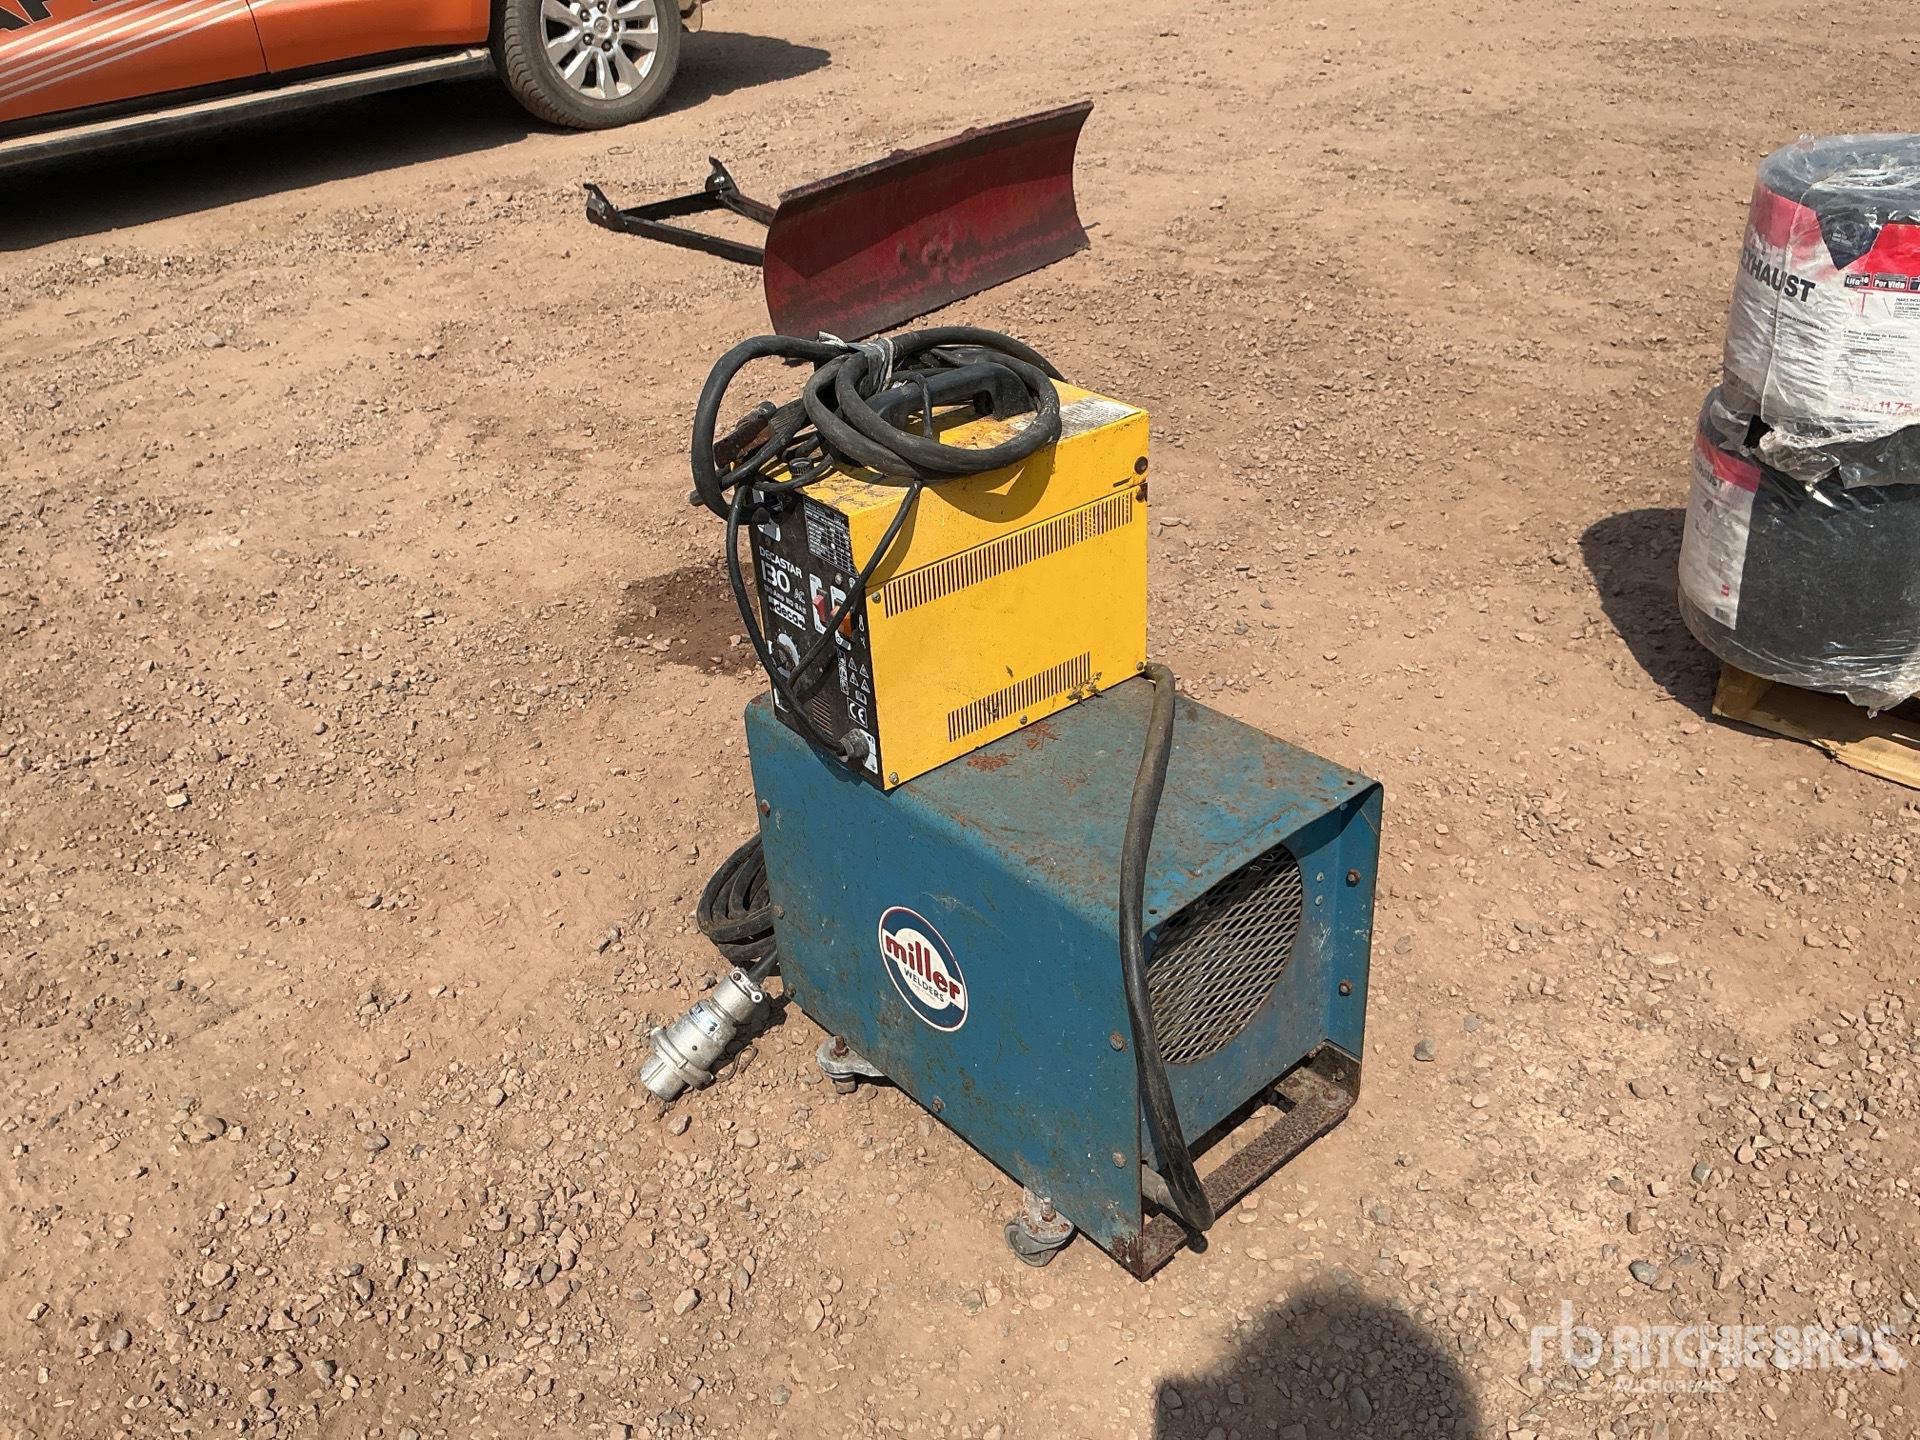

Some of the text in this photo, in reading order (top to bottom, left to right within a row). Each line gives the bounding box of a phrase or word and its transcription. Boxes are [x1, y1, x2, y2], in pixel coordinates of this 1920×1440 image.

[1741, 247, 1816, 302] EXHAUST
[759, 546, 802, 579] DECASTAR
[885, 935, 961, 1000] miller
[904, 967, 945, 1002] WELDERS
